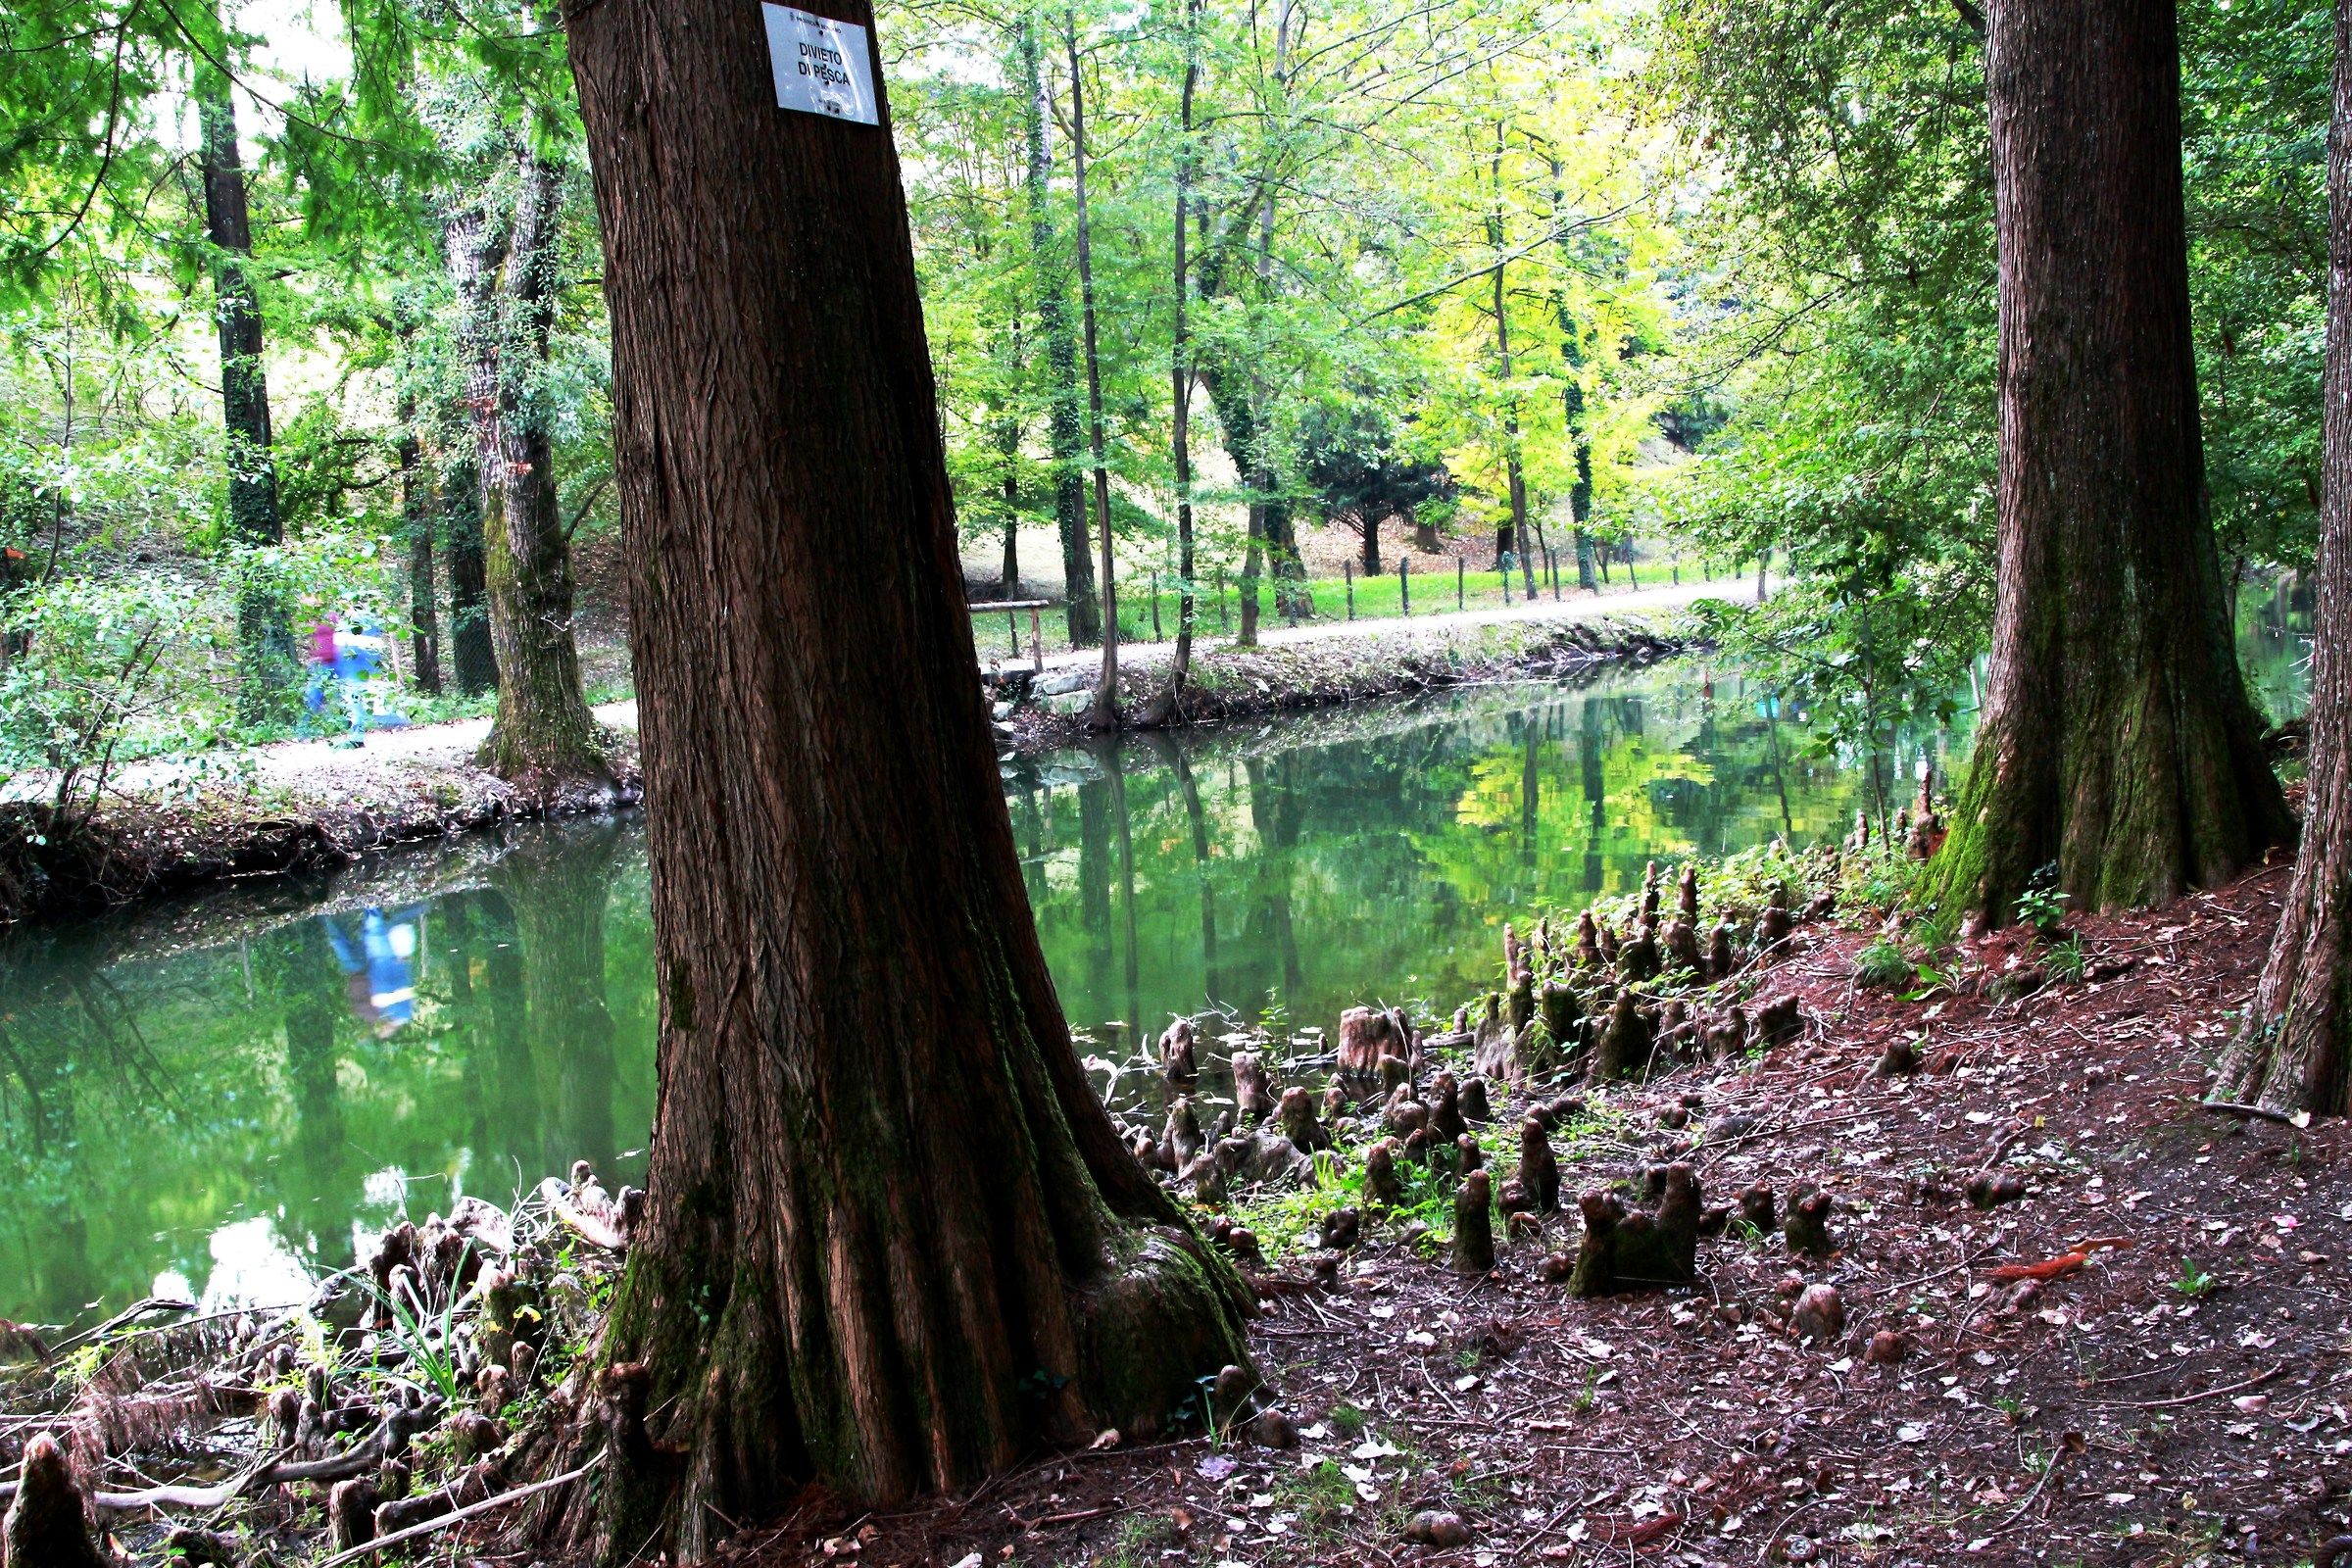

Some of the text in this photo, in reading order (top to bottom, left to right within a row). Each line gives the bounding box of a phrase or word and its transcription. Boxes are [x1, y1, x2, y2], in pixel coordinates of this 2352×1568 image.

[799, 42, 842, 66] DIVIETO
[798, 62, 851, 86] DI PESCA
